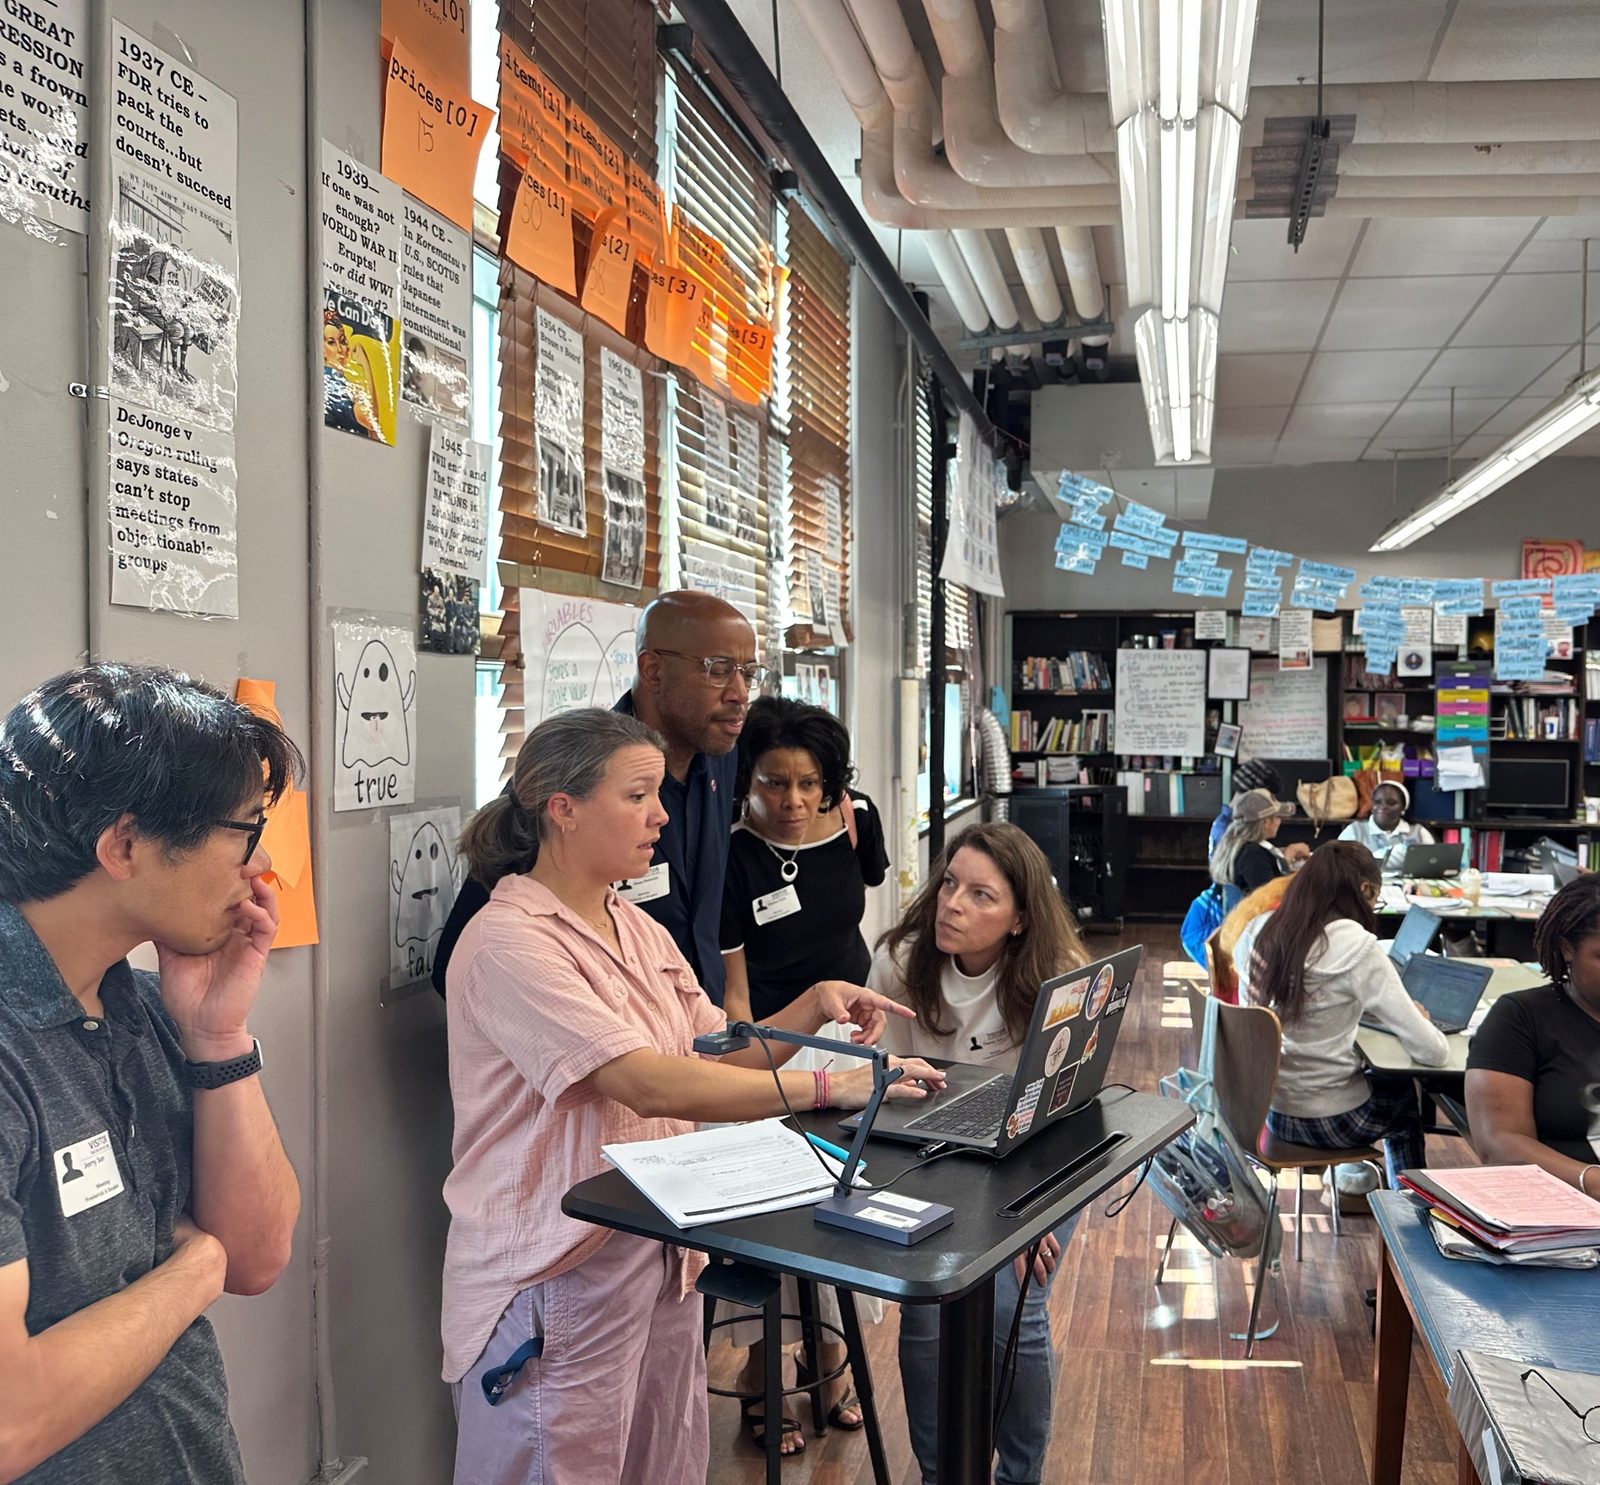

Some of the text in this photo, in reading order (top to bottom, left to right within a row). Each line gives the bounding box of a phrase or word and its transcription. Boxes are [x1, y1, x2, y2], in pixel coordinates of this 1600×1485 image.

[4, 0, 75, 48] GREAT
[120, 36, 164, 76] 1937
[170, 70, 194, 98] CE
[14, 61, 24, 76] a
[30, 66, 88, 108] frown
[118, 62, 209, 130] FDR tries to
[390, 57, 478, 137] prices[0]
[505, 49, 560, 120] items[1]
[118, 90, 184, 137] pack the
[418, 110, 434, 152] 15
[572, 115, 620, 176] items[2]
[116, 136, 232, 210] doesn't succeed
[322, 172, 395, 225] If one was not
[336, 204, 380, 235] enough?
[404, 206, 428, 232] 1944
[432, 224, 446, 242] CE
[338, 242, 376, 272] Erupts!
[361, 234, 386, 258] WAR
[389, 251, 398, 264] II
[404, 226, 466, 272] In Korematsu v
[348, 269, 366, 286] did
[369, 278, 394, 298] WWI
[403, 264, 444, 293] rules that
[427, 257, 460, 285] SCOTUS
[338, 296, 360, 323] Can
[362, 296, 388, 312] end?
[403, 280, 442, 309] Japanese
[403, 297, 450, 330] internment
[452, 325, 466, 338] was
[403, 317, 462, 352] constitutional
[116, 407, 192, 441] DeJonge v
[118, 432, 218, 473] Oregon ruling
[116, 458, 198, 487] says states
[434, 470, 446, 486] The
[470, 470, 487, 482] and
[116, 482, 190, 510] can't stop
[116, 506, 220, 535] meetings from
[118, 528, 214, 555] objectionable
[118, 554, 168, 574] groups
[354, 770, 398, 803] true
[406, 946, 432, 978] fal
